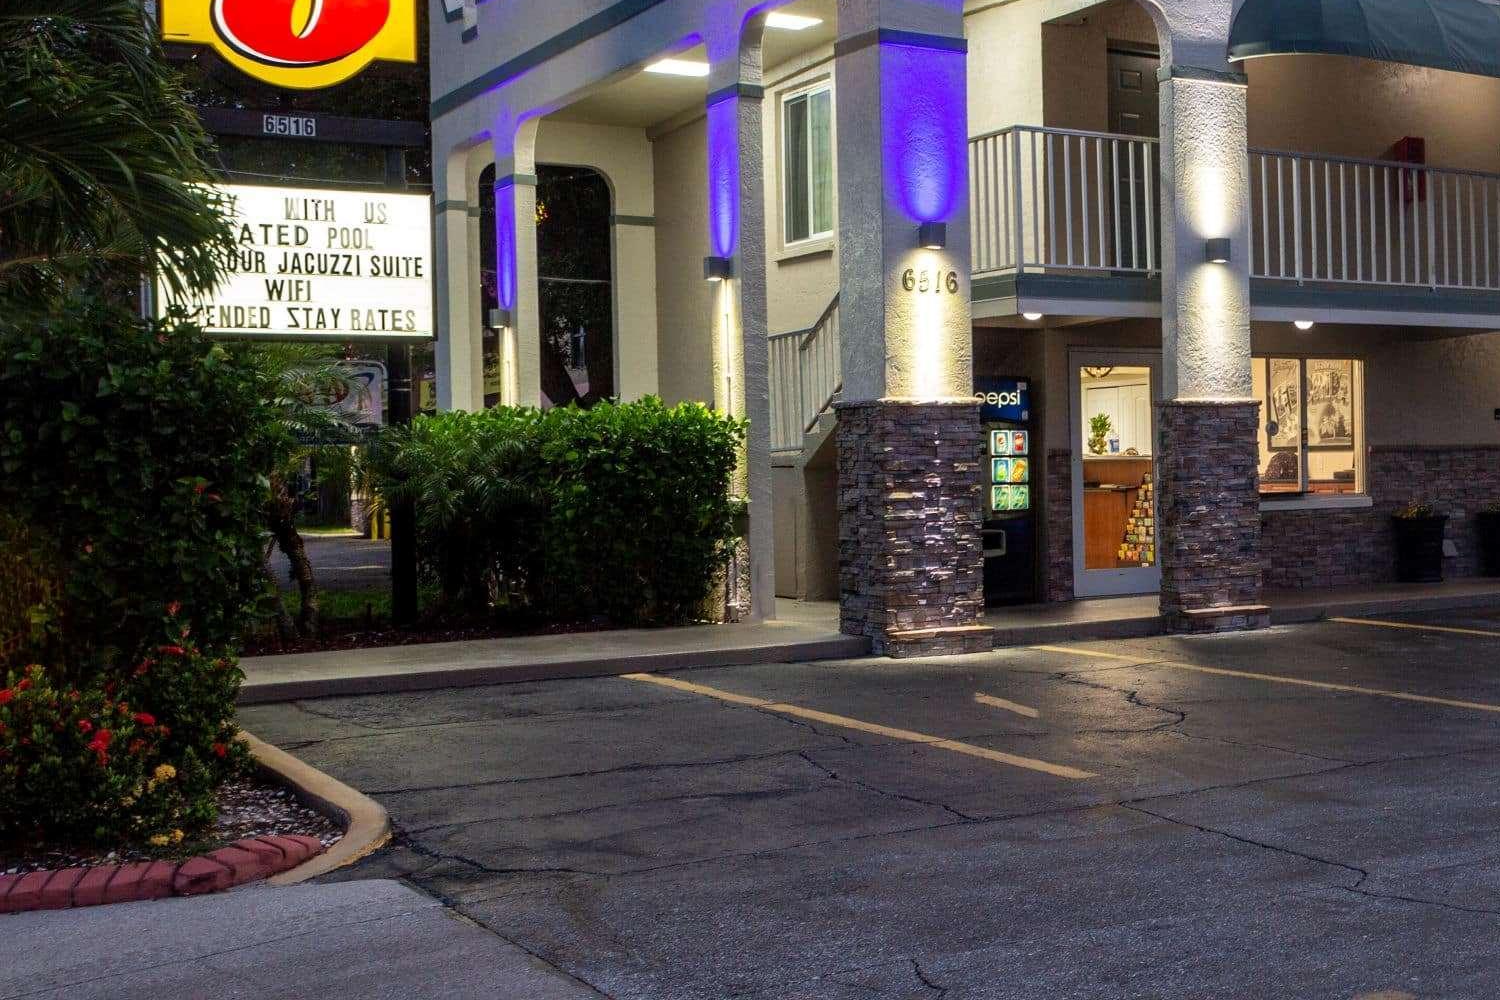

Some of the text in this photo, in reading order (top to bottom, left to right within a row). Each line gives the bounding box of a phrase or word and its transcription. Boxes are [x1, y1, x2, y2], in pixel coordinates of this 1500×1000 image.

[264, 115, 315, 136] 6516
[284, 197, 388, 223] WITH US
[238, 223, 374, 249] ATED POOL
[226, 250, 423, 277] OUR JACUZZI SUITE
[265, 279, 312, 302] WIFI
[902, 268, 959, 294] 6516
[194, 304, 271, 329] ENDED
[351, 309, 416, 331] RATES
